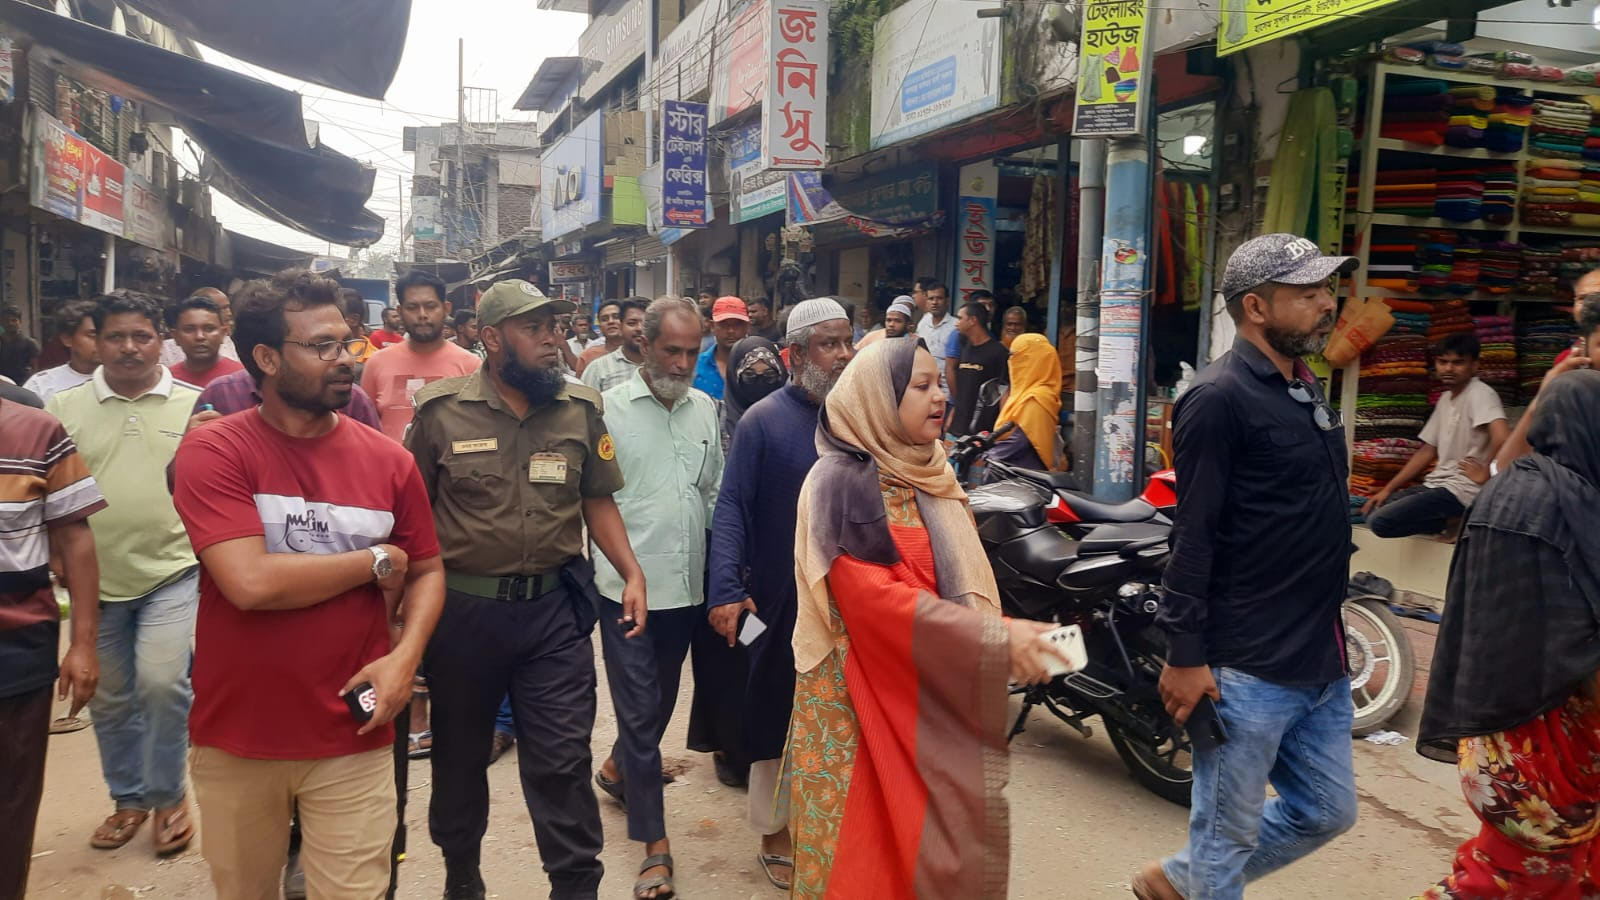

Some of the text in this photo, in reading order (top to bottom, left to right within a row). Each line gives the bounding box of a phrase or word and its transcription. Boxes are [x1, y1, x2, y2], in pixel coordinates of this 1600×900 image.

[606, 1, 643, 55] SAMSUNG
[1086, 22, 1141, 48] হাউজ
[668, 104, 705, 136] স্টার
